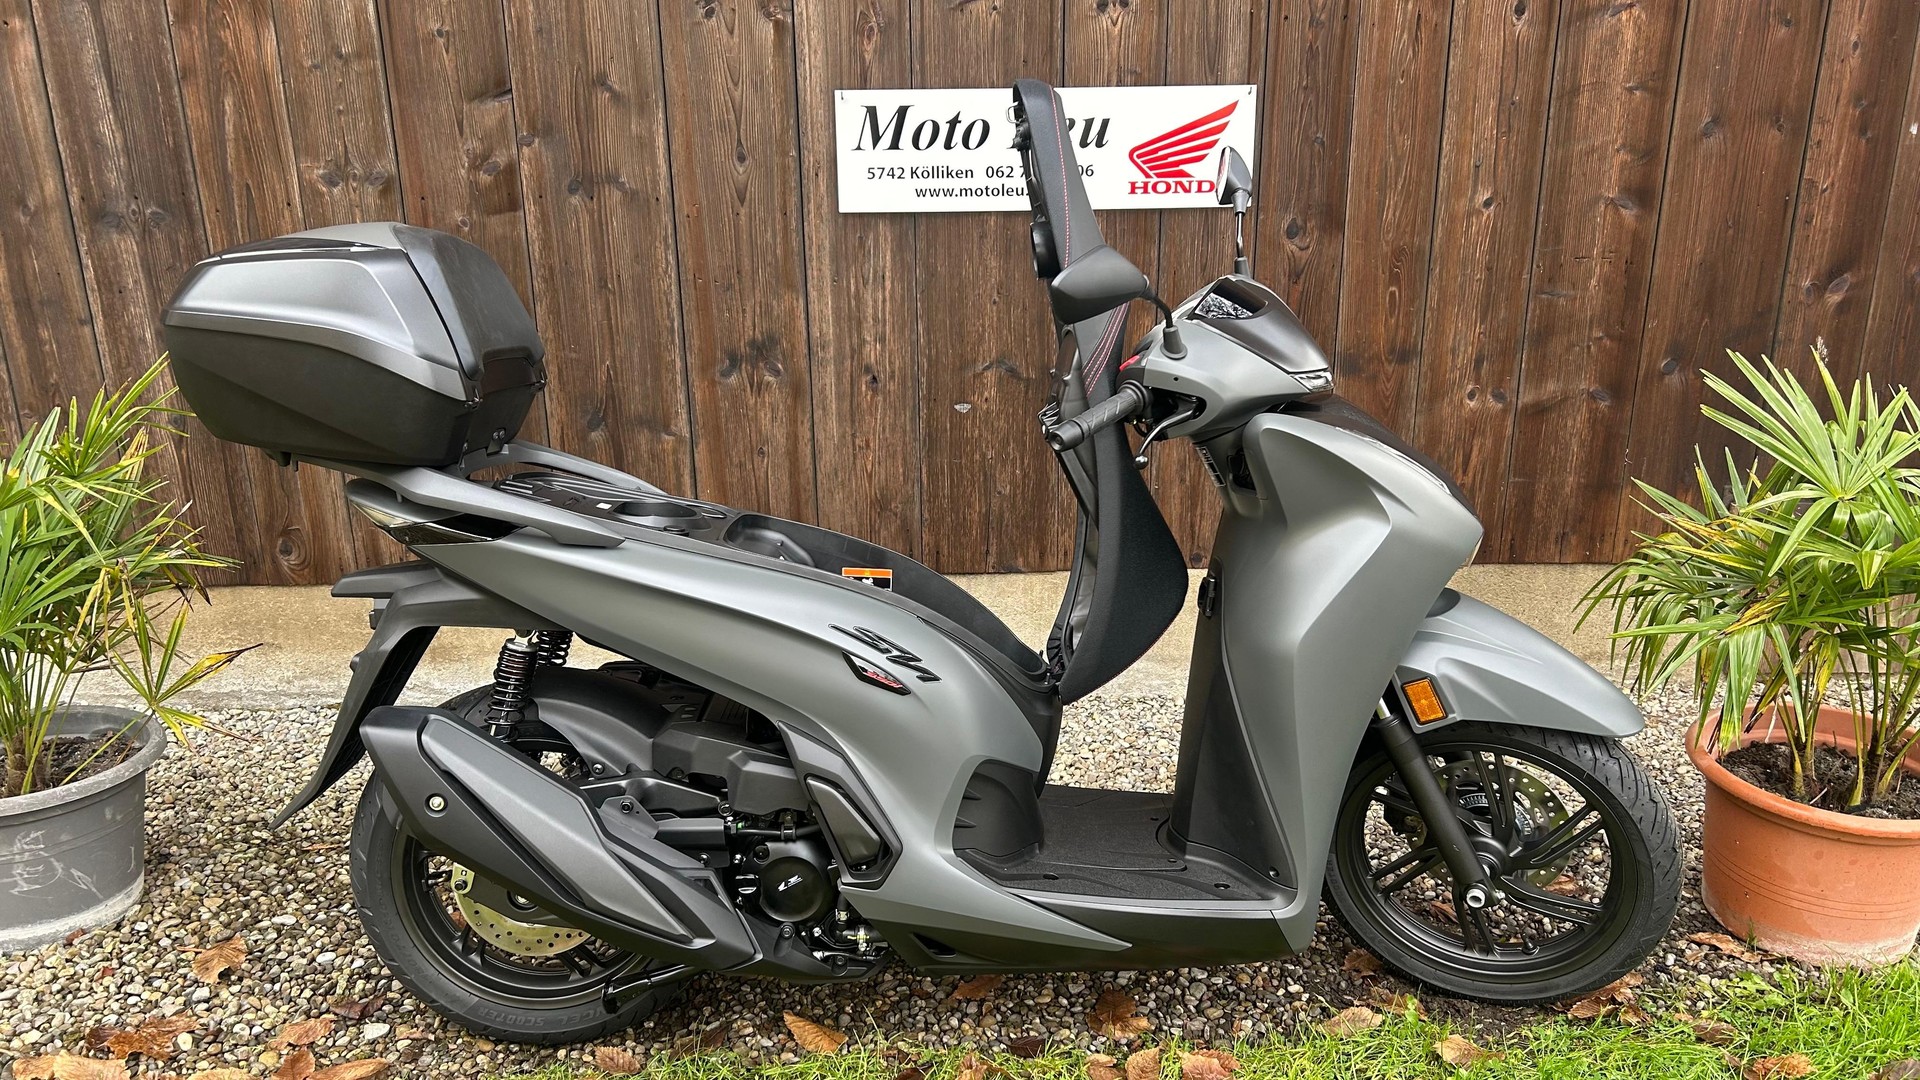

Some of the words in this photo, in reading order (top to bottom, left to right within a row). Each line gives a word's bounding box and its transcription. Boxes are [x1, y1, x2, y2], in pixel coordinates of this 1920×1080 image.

[851, 104, 991, 151] Moto
[867, 167, 906, 180] 5742
[910, 165, 974, 180] Kölliken
[985, 165, 1014, 178] 062
[915, 183, 1029, 198] www.motoleu.
[1127, 180, 1216, 195] HOND
